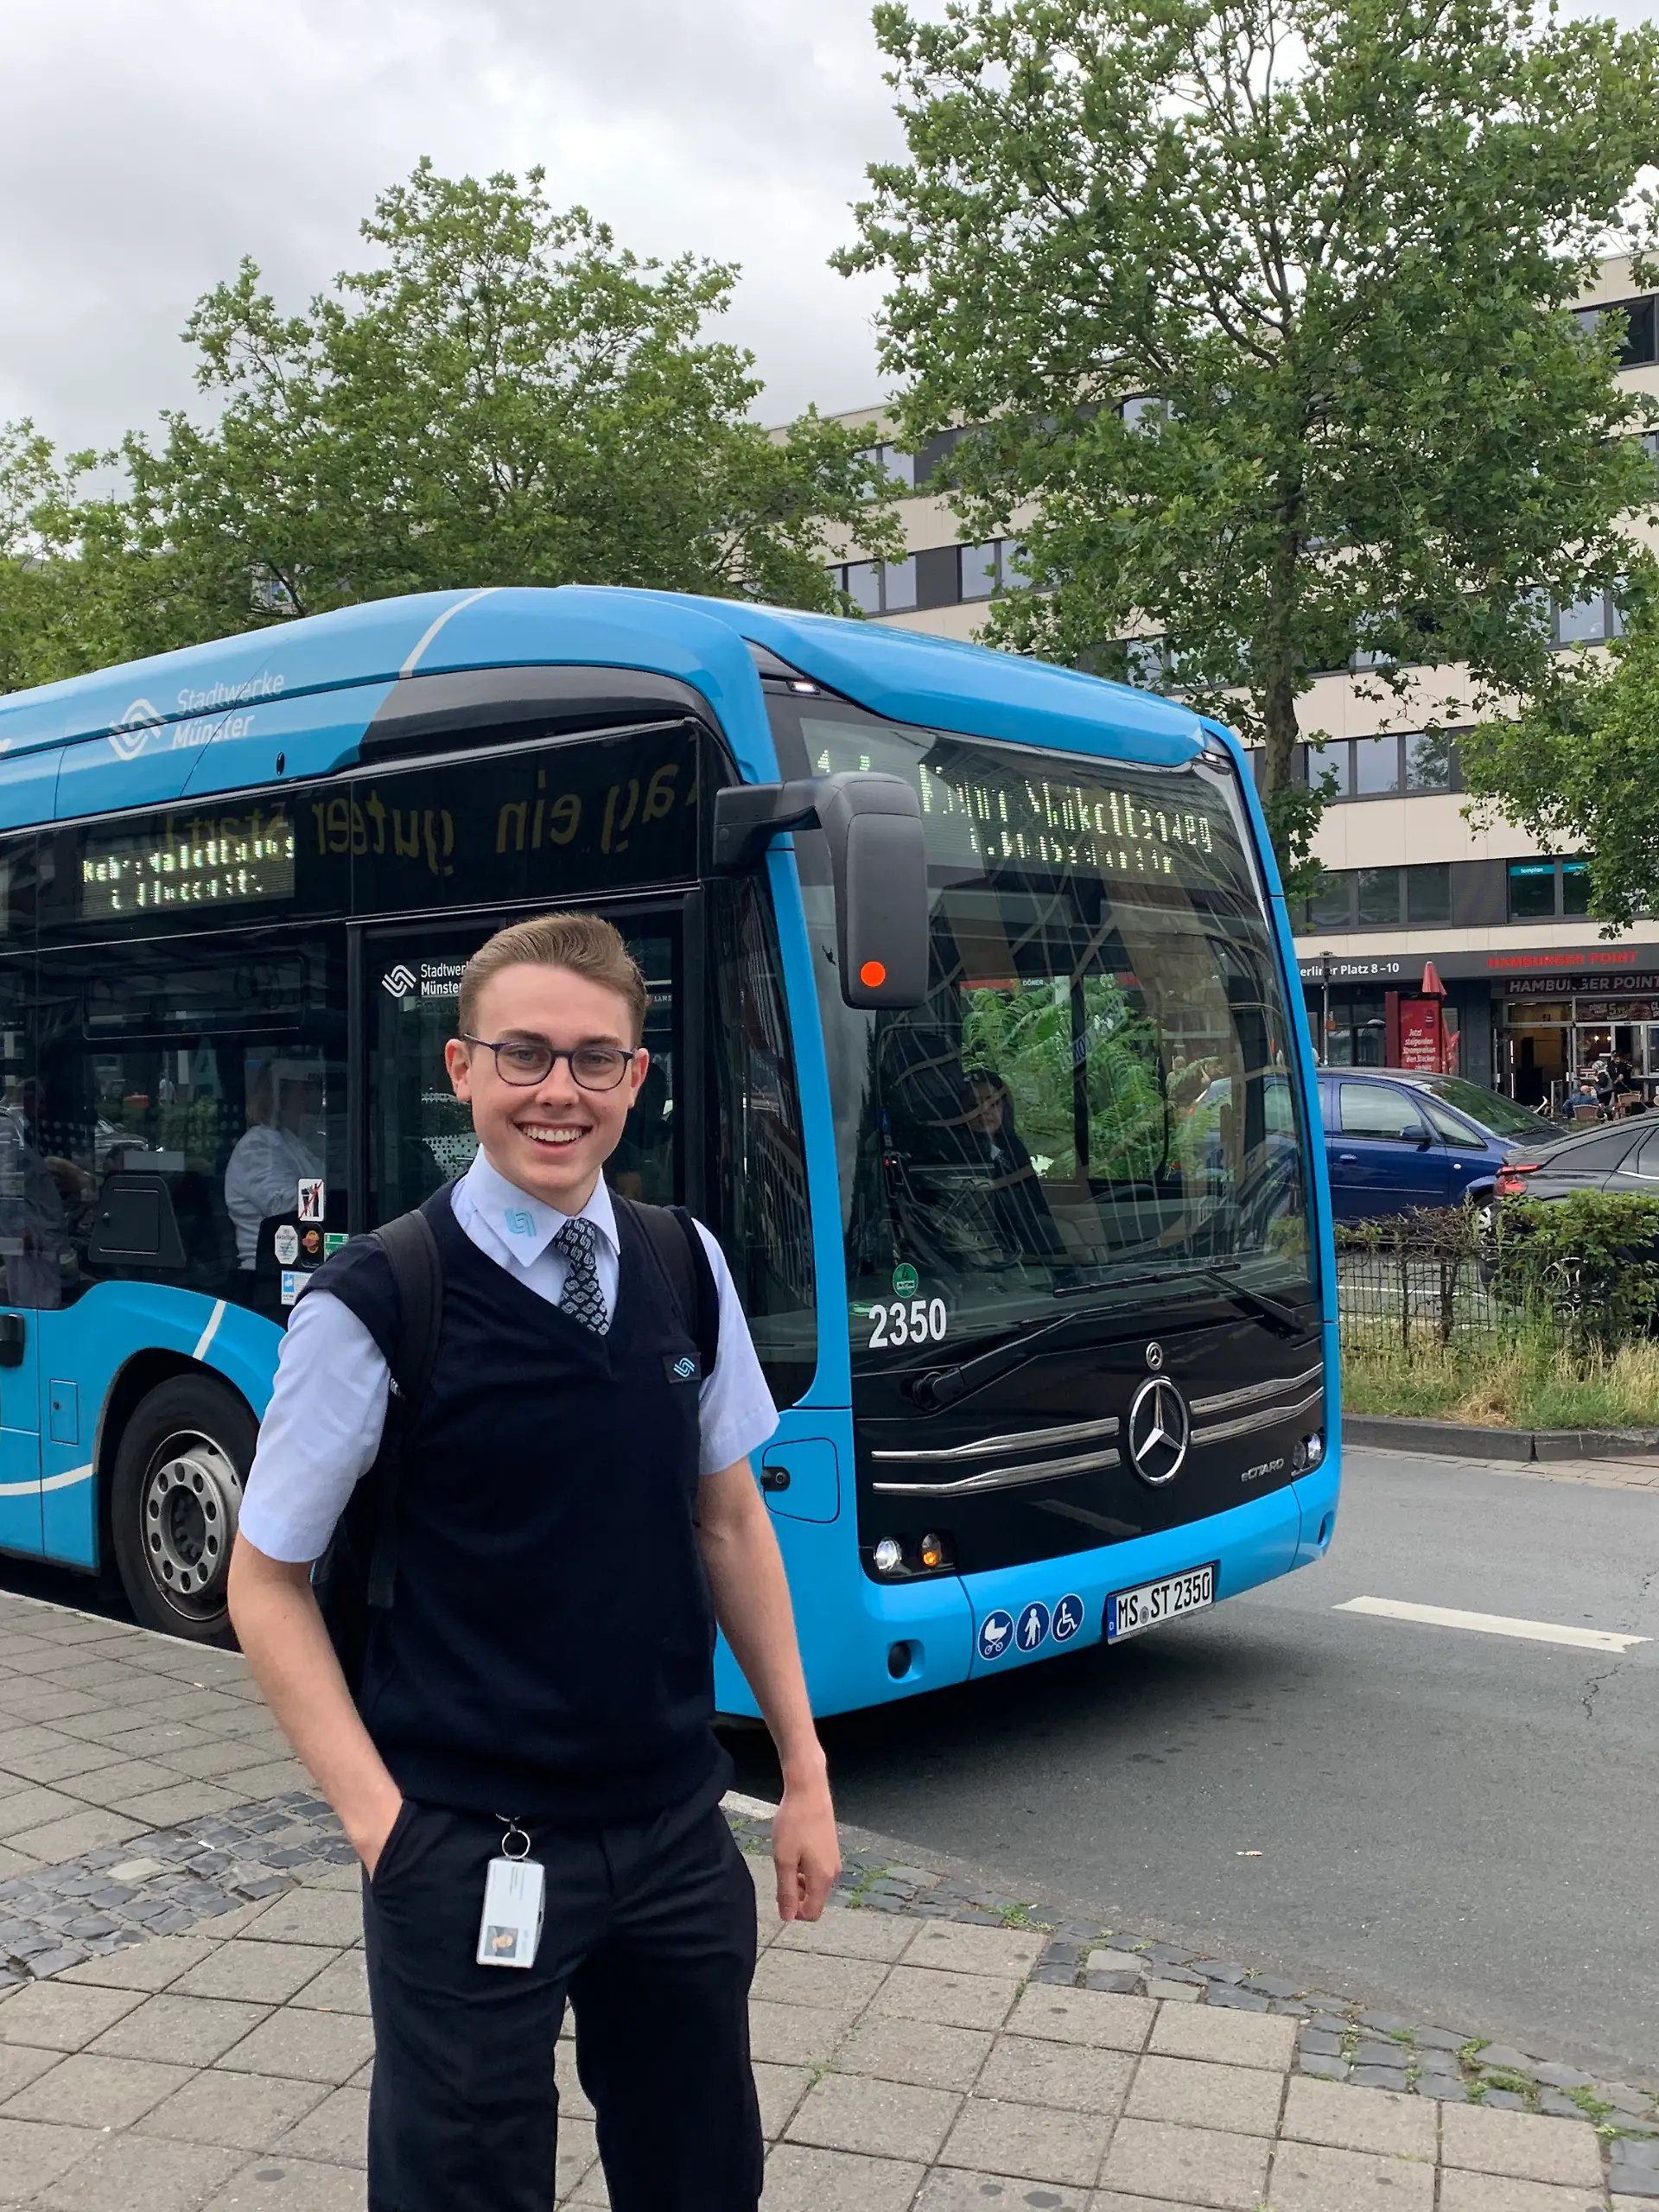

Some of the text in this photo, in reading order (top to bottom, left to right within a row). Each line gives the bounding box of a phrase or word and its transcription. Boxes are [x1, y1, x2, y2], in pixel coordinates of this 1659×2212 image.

[176, 670, 284, 715] Stadtwerke
[172, 714, 256, 749] Münster
[421, 961, 468, 978] Stadtwer
[1341, 964, 1369, 975] Platz
[1487, 951, 1638, 969] HAMBURGER POINT
[868, 1298, 947, 1349] 2350
[1117, 1571, 1211, 1630] MS ST 2350
